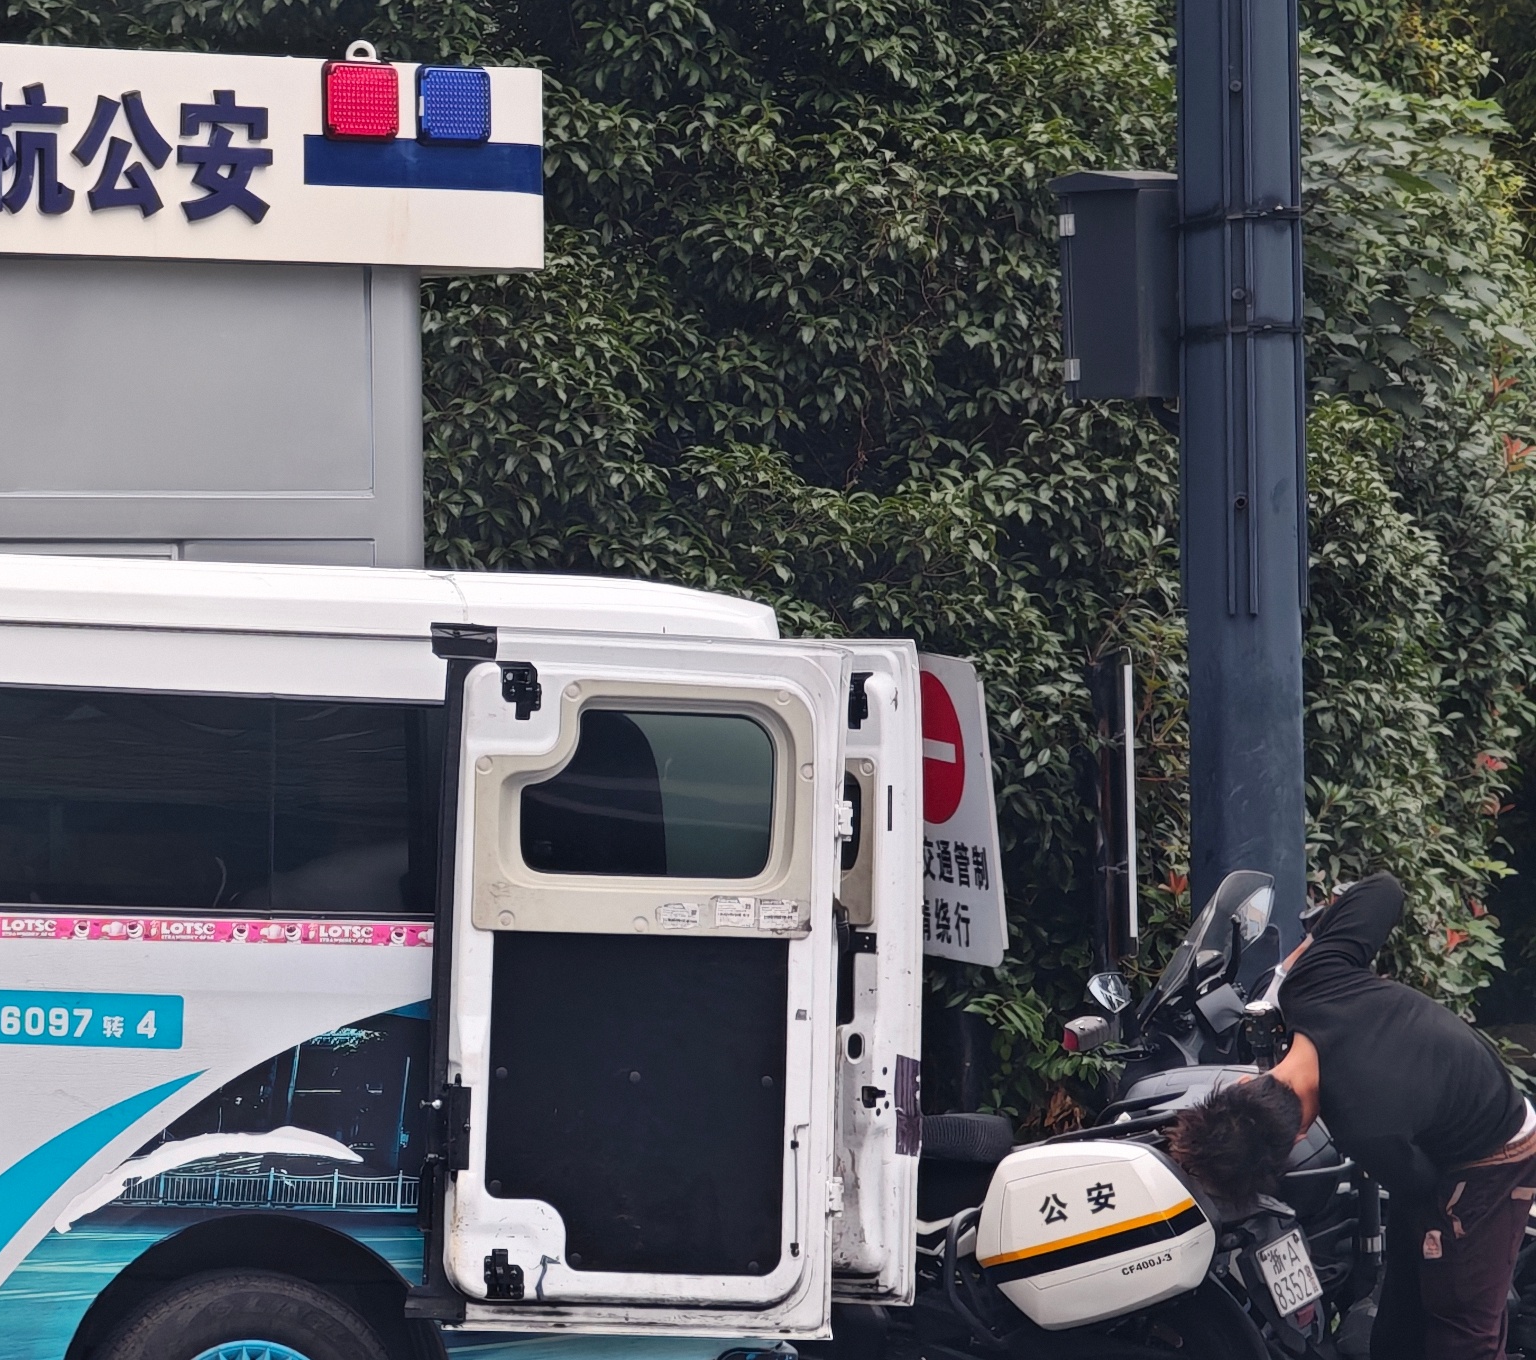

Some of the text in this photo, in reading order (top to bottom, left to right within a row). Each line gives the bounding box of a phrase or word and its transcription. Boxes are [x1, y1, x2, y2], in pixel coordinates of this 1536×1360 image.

[103, 1016, 125, 1038] 转
[137, 1010, 157, 1039] 4
[1039, 1182, 1116, 1225] 公安
[1121, 1253, 1173, 1276] CF400J-3
[1273, 1268, 1313, 1311] 8352
